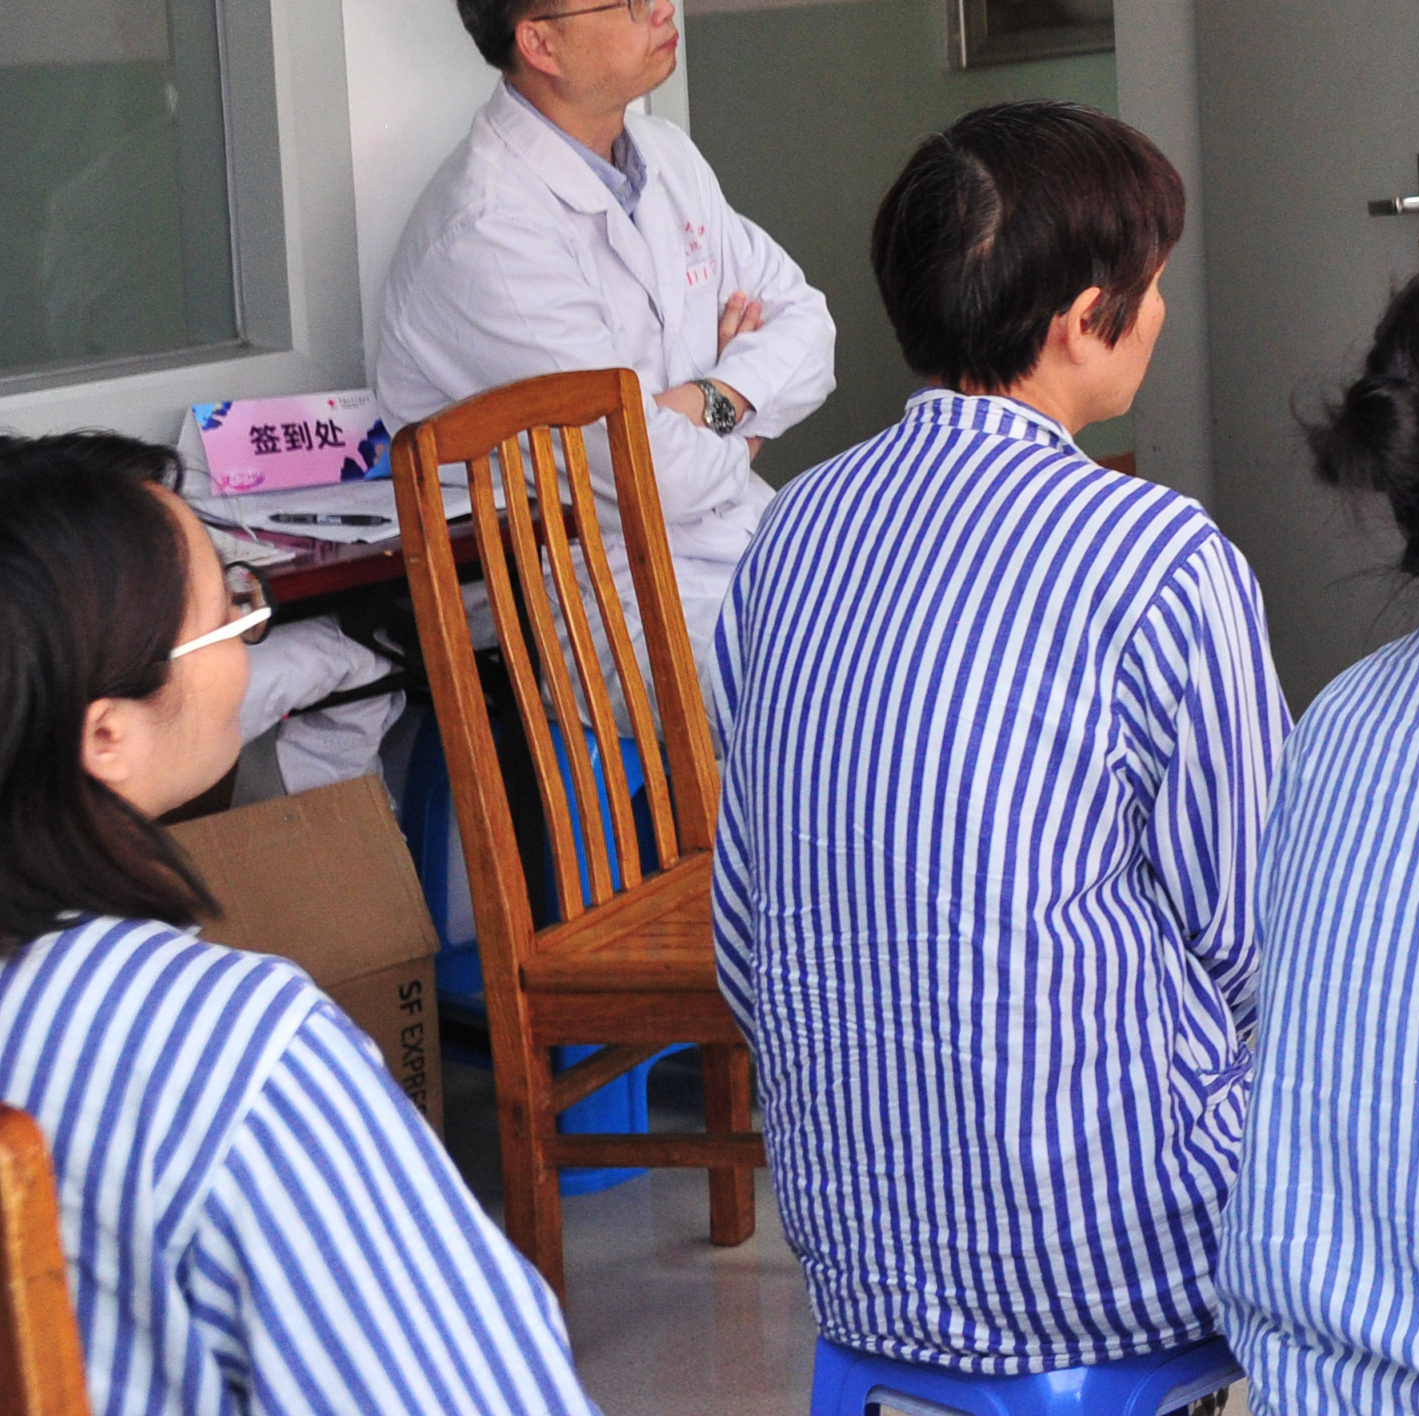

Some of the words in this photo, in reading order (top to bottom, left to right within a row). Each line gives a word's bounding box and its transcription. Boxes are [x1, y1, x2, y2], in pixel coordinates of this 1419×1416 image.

[250, 419, 346, 456] 签到处
[399, 980, 423, 1015] SF
